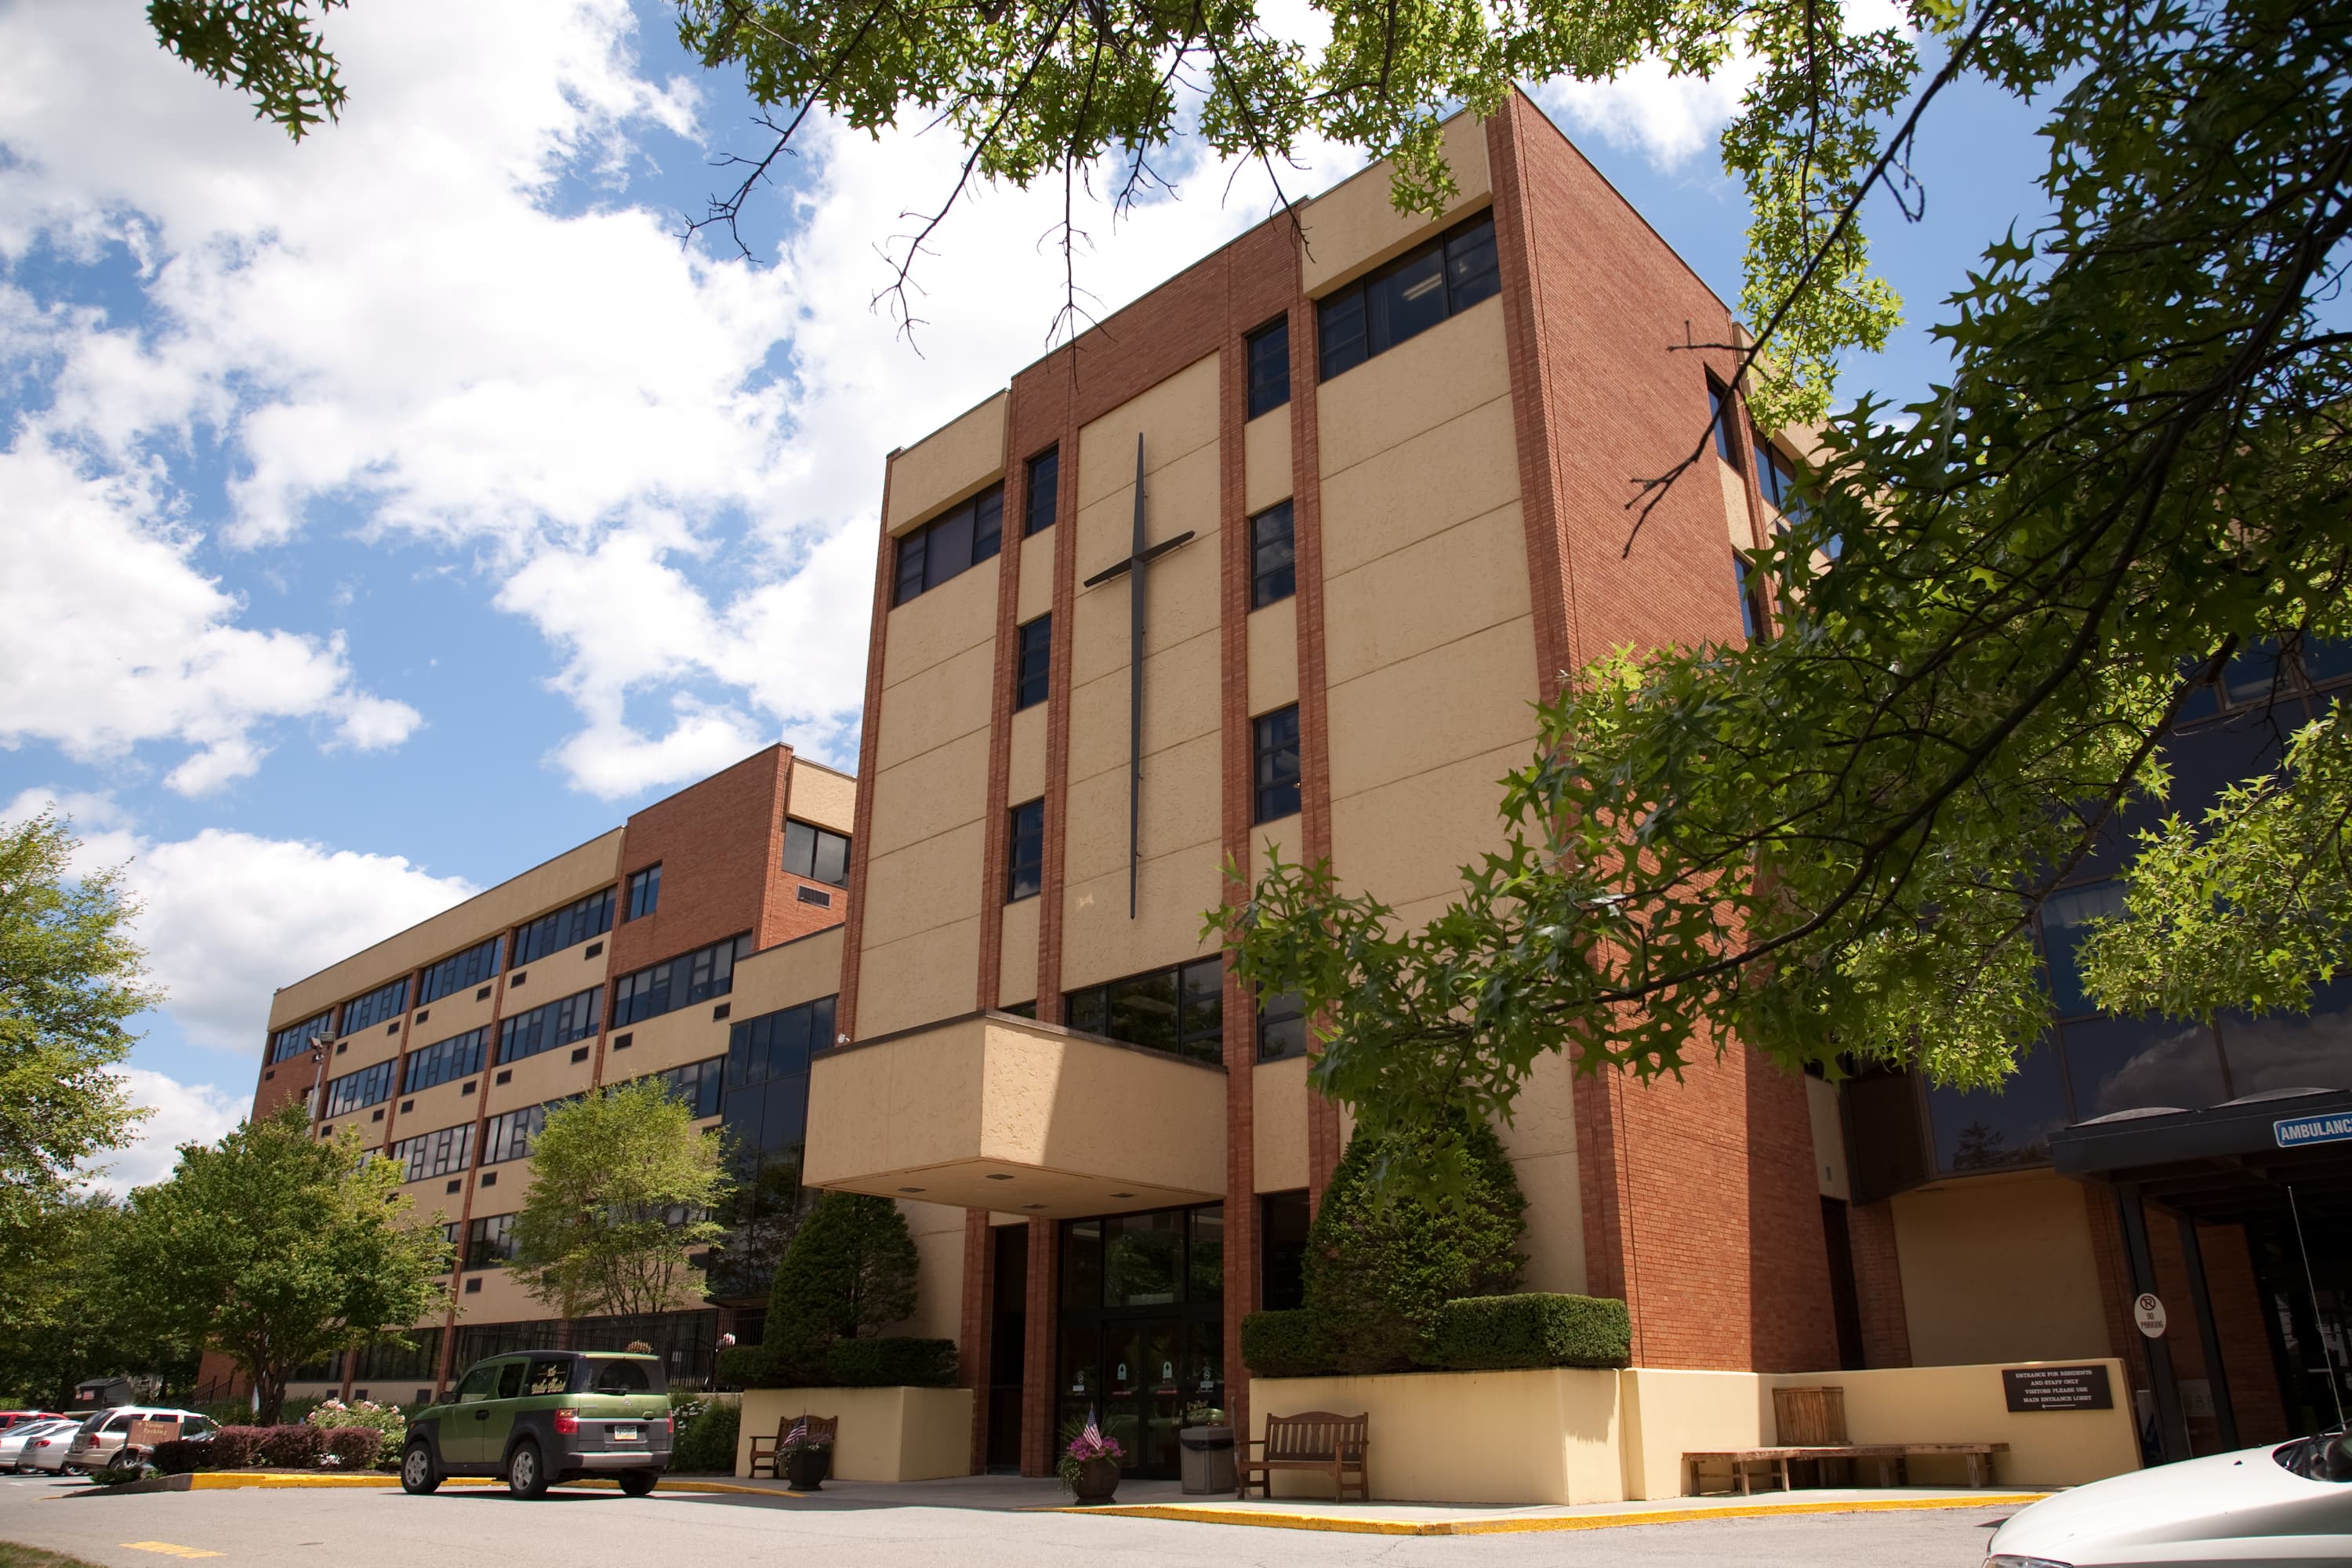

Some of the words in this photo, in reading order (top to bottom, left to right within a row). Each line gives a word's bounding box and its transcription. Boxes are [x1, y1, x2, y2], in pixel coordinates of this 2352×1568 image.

[2281, 1118, 2352, 1141] AMBULANC
[2140, 1320, 2164, 1329] PARKING
[143, 1427, 167, 1436] Parking
